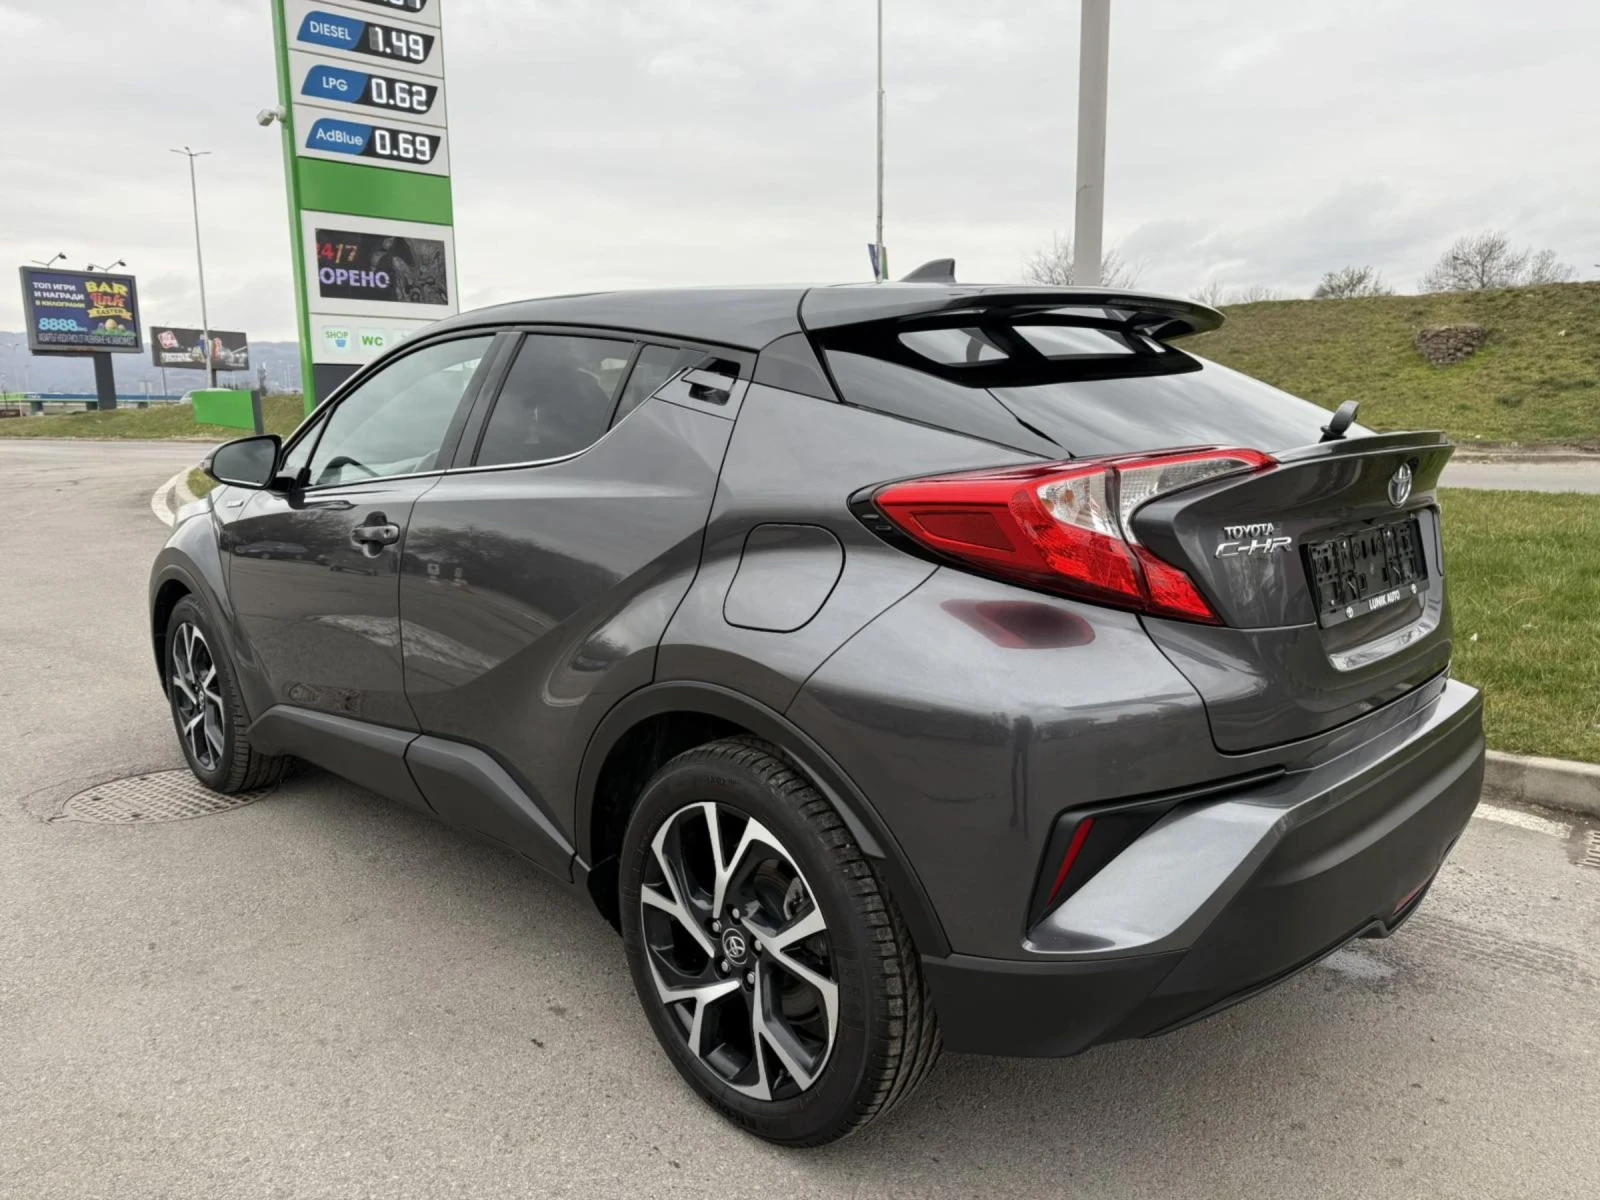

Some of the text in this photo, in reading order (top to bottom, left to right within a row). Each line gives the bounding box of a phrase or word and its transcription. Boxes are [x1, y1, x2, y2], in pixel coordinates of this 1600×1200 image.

[309, 20, 425, 61] DIESEL 1.49
[322, 76, 428, 111] LPG 0.62
[316, 128, 431, 161] AdBlue 0.69
[32, 281, 76, 291] ТОП ИГРИ
[85, 280, 128, 296] BAR
[43, 292, 85, 300] НАГРАДИ
[38, 317, 77, 332] 8888
[325, 331, 349, 339] SHOP
[361, 335, 383, 346] WC
[1223, 522, 1275, 539] TOYOTA
[1215, 536, 1292, 559] C-HR
[1386, 589, 1400, 604] AUTO
